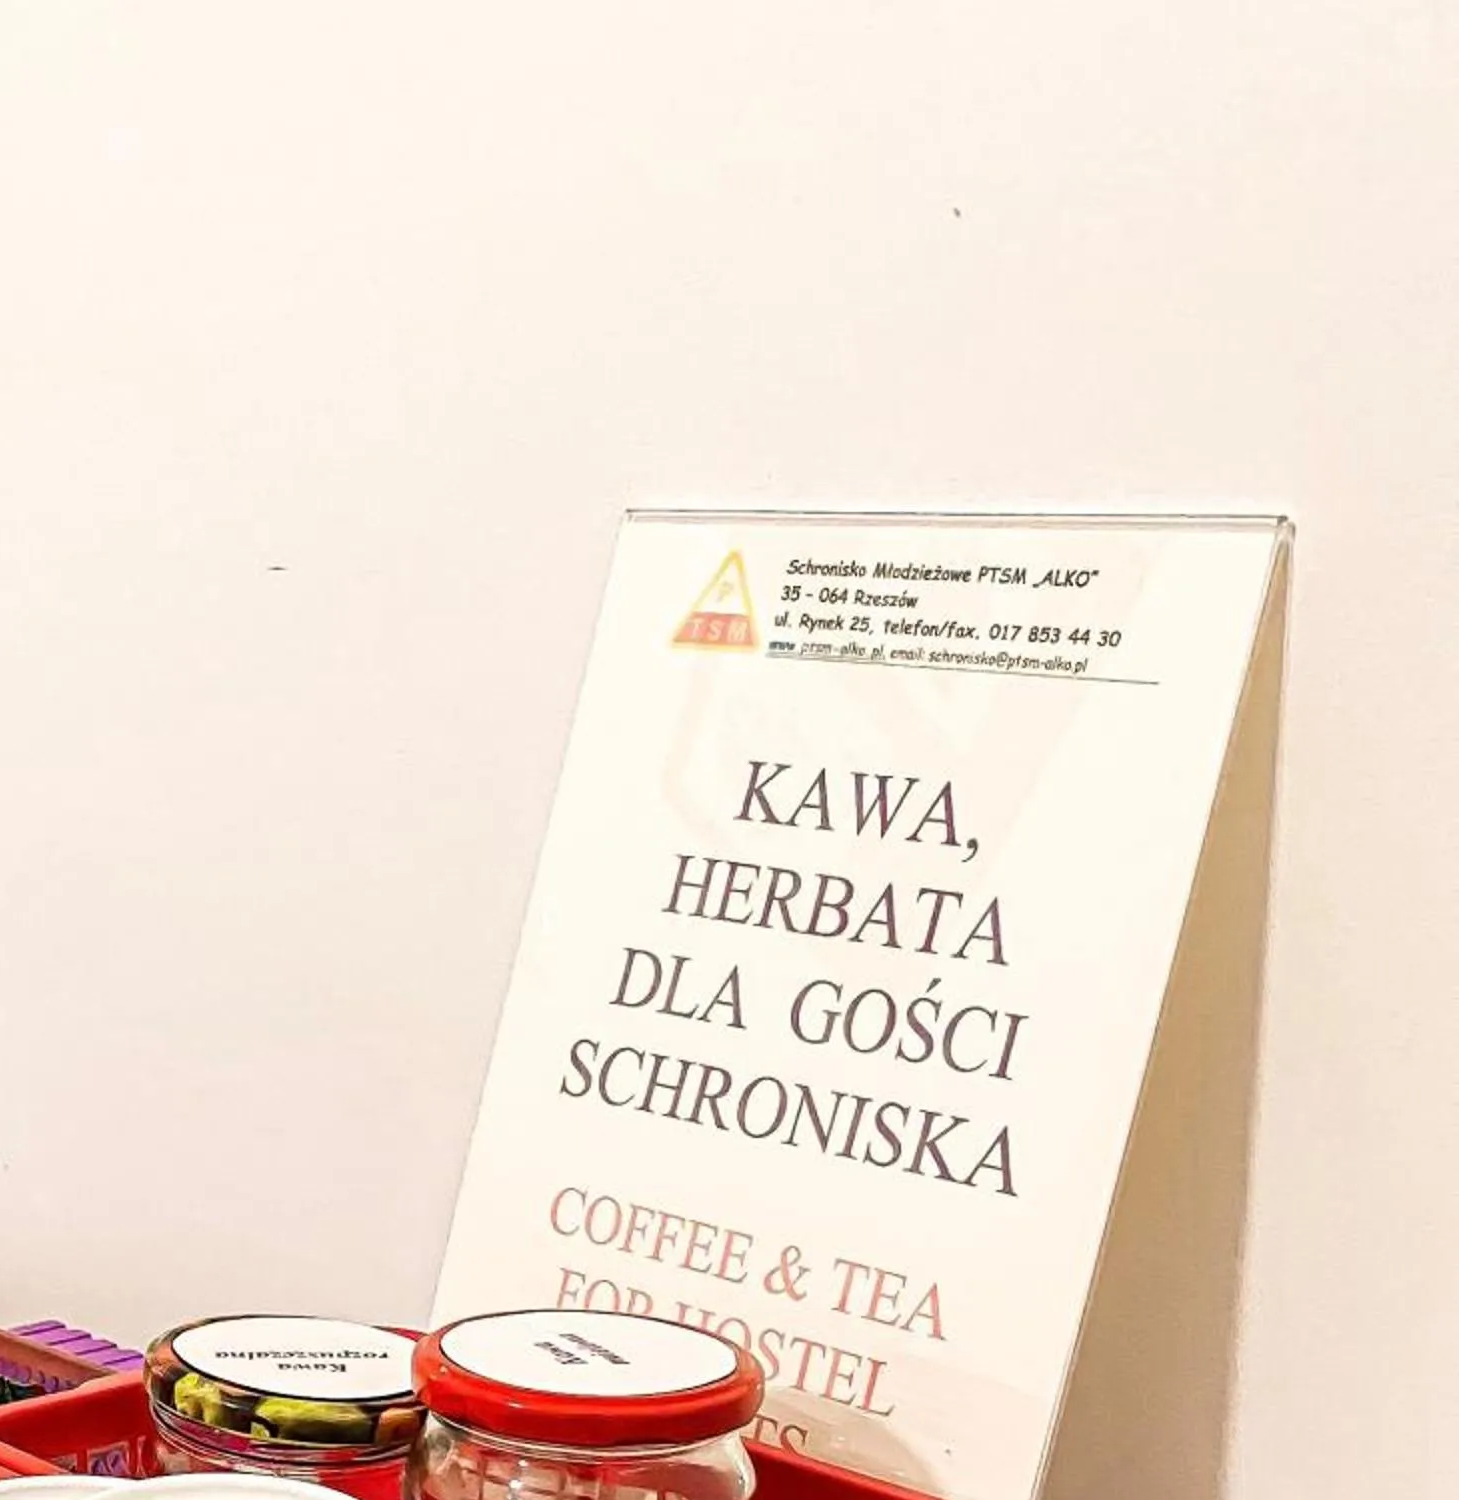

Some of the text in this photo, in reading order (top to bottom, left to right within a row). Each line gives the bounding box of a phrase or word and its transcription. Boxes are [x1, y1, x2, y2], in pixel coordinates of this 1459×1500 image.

[781, 585, 801, 602] 35
[818, 587, 848, 604] 064
[853, 589, 919, 609] Rzeszów
[786, 559, 867, 577] Schronisko
[873, 561, 972, 583] Młodzieżowe
[977, 566, 1027, 584] PTSM
[774, 612, 1122, 648] ul. Rynek 25, telefon/fax. 017 853 44 30
[733, 760, 979, 863] KAWA,
[661, 853, 1010, 967] HERBATA
[609, 946, 1030, 1081] DLA GOŚCI
[559, 1038, 1019, 1197] SCHRONISKA
[549, 1186, 947, 1342] COFFEE & TEA
[276, 1362, 348, 1374] Kawa
